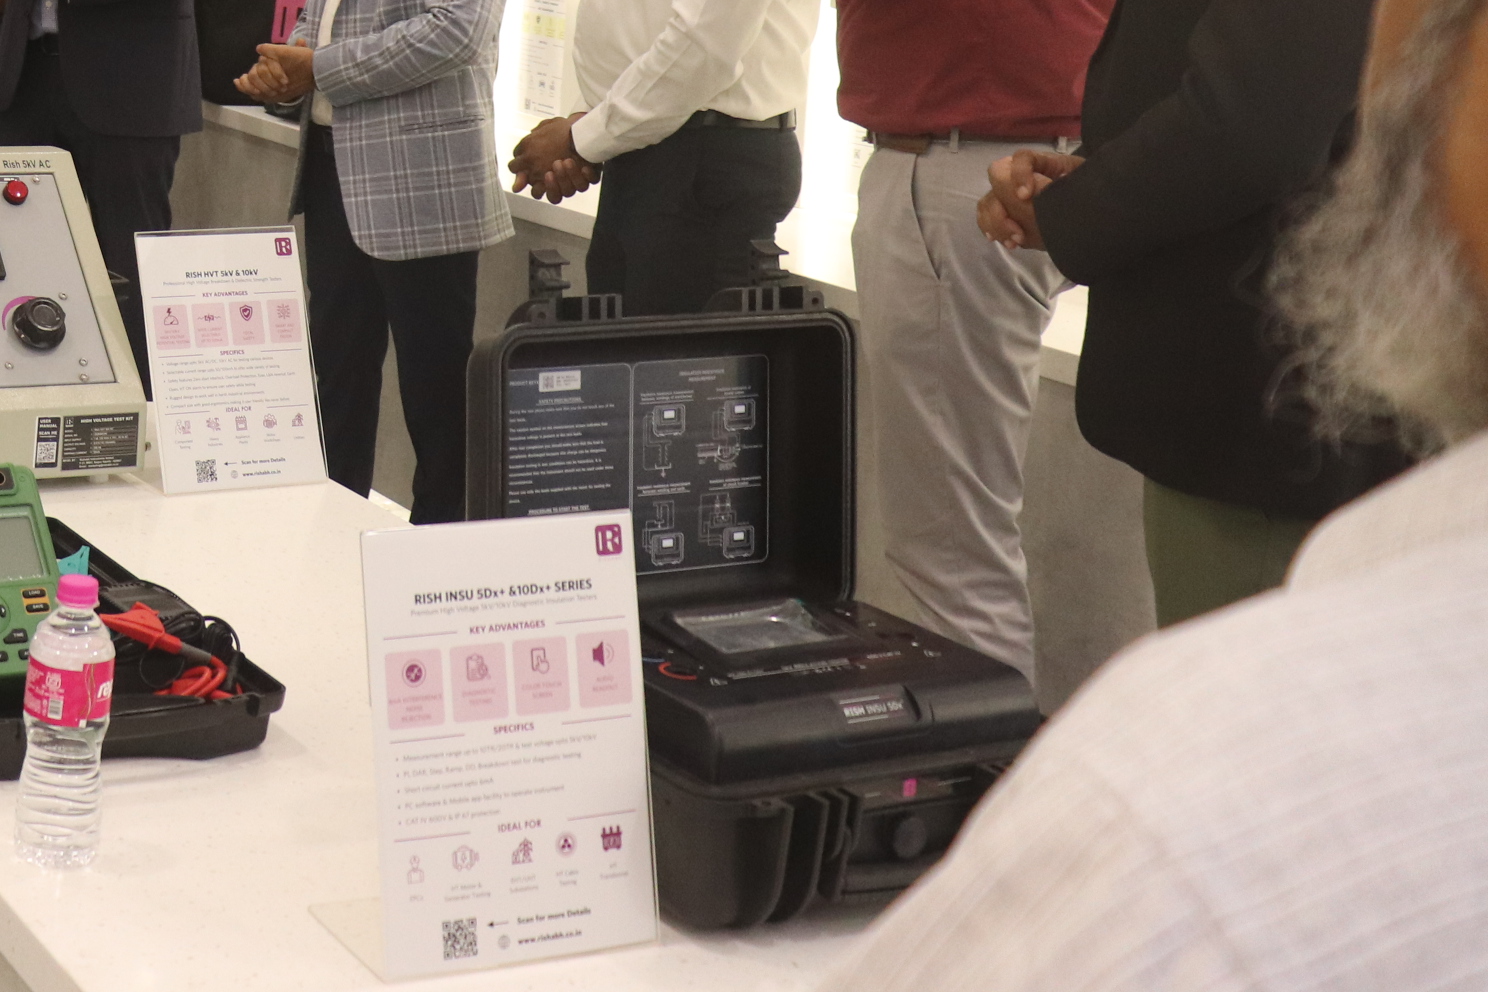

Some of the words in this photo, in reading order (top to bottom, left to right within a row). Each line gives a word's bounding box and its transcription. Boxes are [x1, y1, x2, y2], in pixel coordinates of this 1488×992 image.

[3, 160, 20, 169] Rish
[22, 160, 36, 168] 5kV
[184, 270, 202, 278] RISH
[220, 269, 233, 277] 5kV
[241, 268, 259, 276] 10kV
[413, 591, 442, 605] RISH
[444, 588, 474, 602] INSU
[475, 585, 506, 599] 5Dx+
[508, 581, 551, 597] &10Dx+
[553, 578, 593, 593] SERIES
[469, 624, 487, 635] KEY
[488, 618, 545, 633] ADVANTAGES
[493, 721, 534, 735] SPECIFICS
[497, 821, 521, 833] IDEAL
[524, 818, 541, 829] FOR
[516, 914, 534, 925] Scan
[535, 913, 545, 922] for
[546, 910, 565, 921] more
[566, 906, 591, 918] Details
